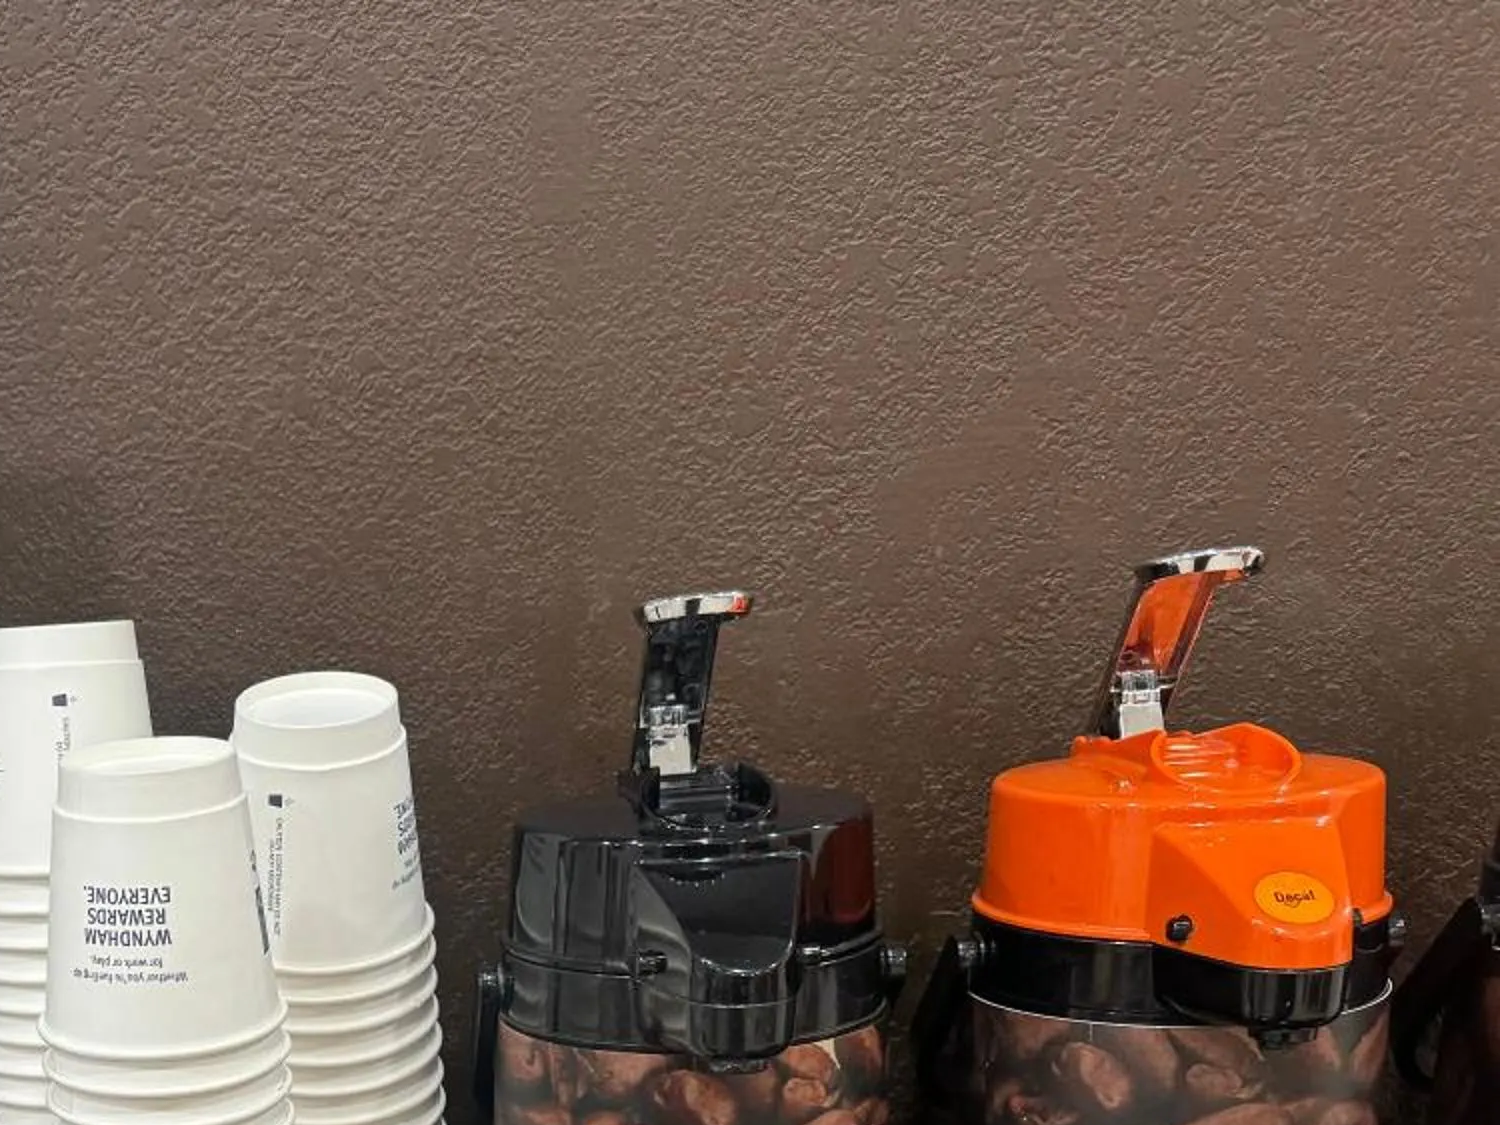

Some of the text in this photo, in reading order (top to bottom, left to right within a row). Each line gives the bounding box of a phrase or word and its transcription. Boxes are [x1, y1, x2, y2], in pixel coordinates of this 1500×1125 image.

[83, 885, 171, 905] EVERYONE.
[87, 907, 166, 926] REWARDS
[83, 928, 173, 947] WYNDHAM
